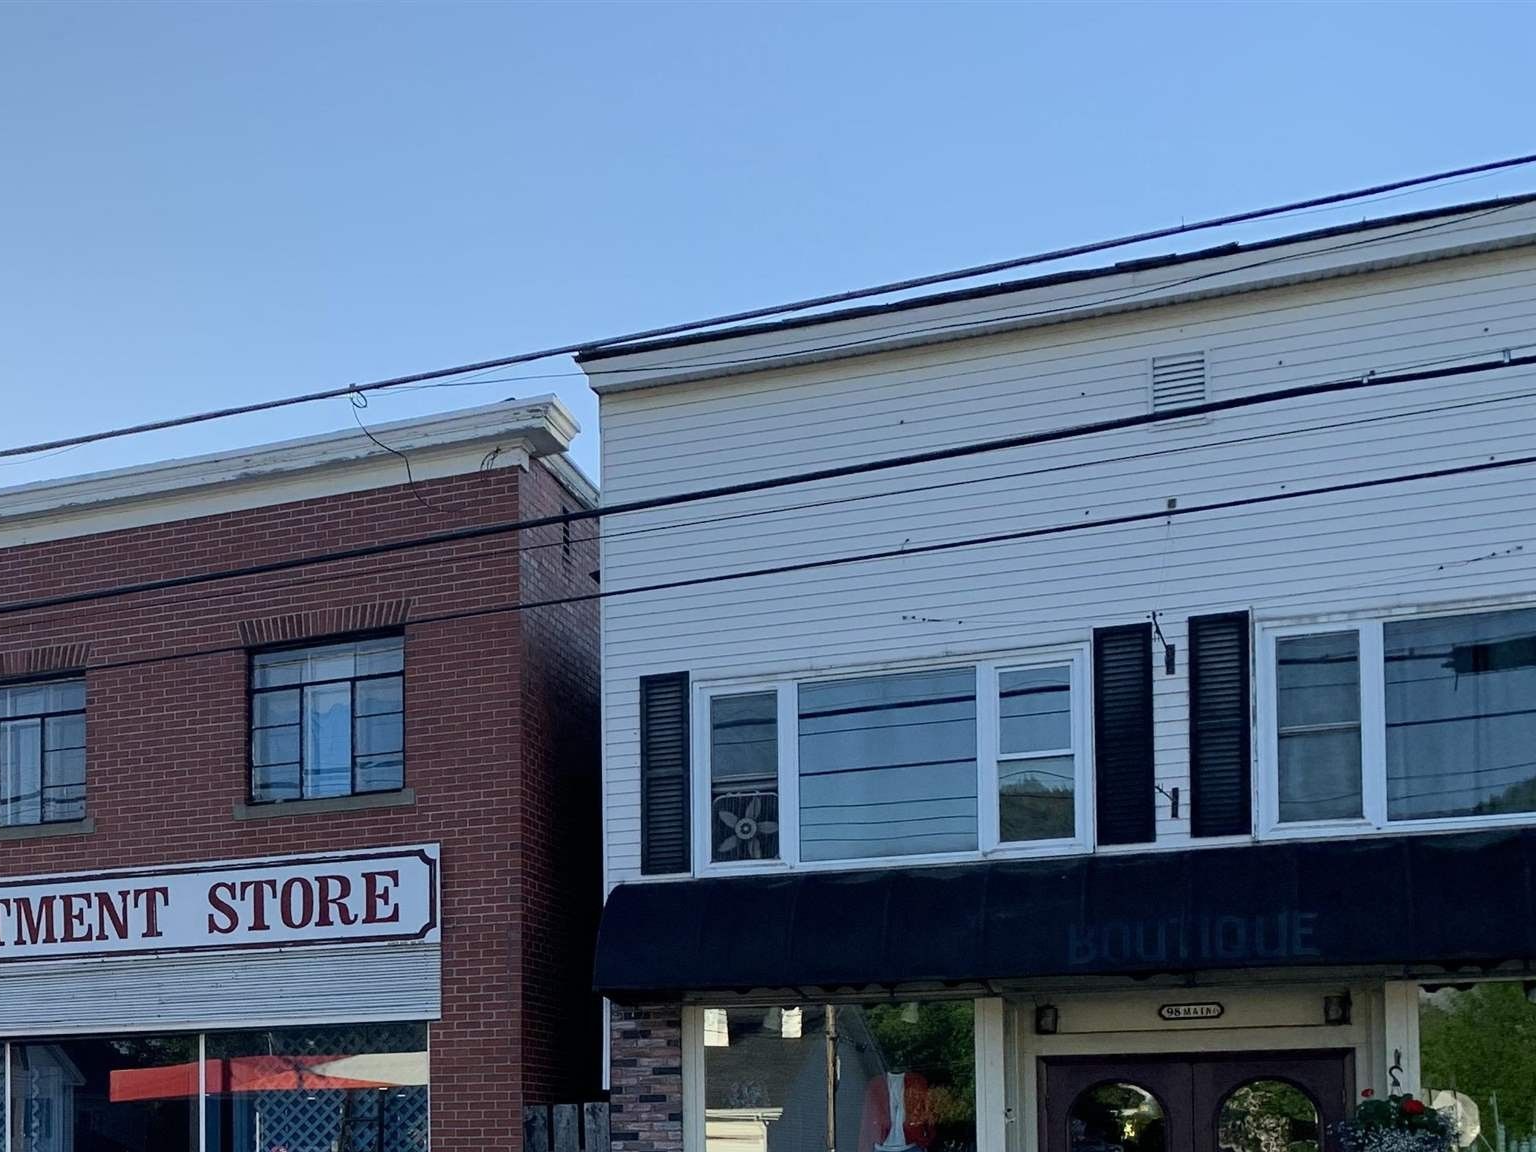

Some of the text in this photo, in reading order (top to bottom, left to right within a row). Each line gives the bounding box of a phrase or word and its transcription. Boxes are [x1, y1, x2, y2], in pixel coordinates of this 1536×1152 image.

[207, 870, 401, 935] STORE
[1068, 910, 1321, 966] BOUTIQUE
[1166, 1007, 1181, 1017] 98
